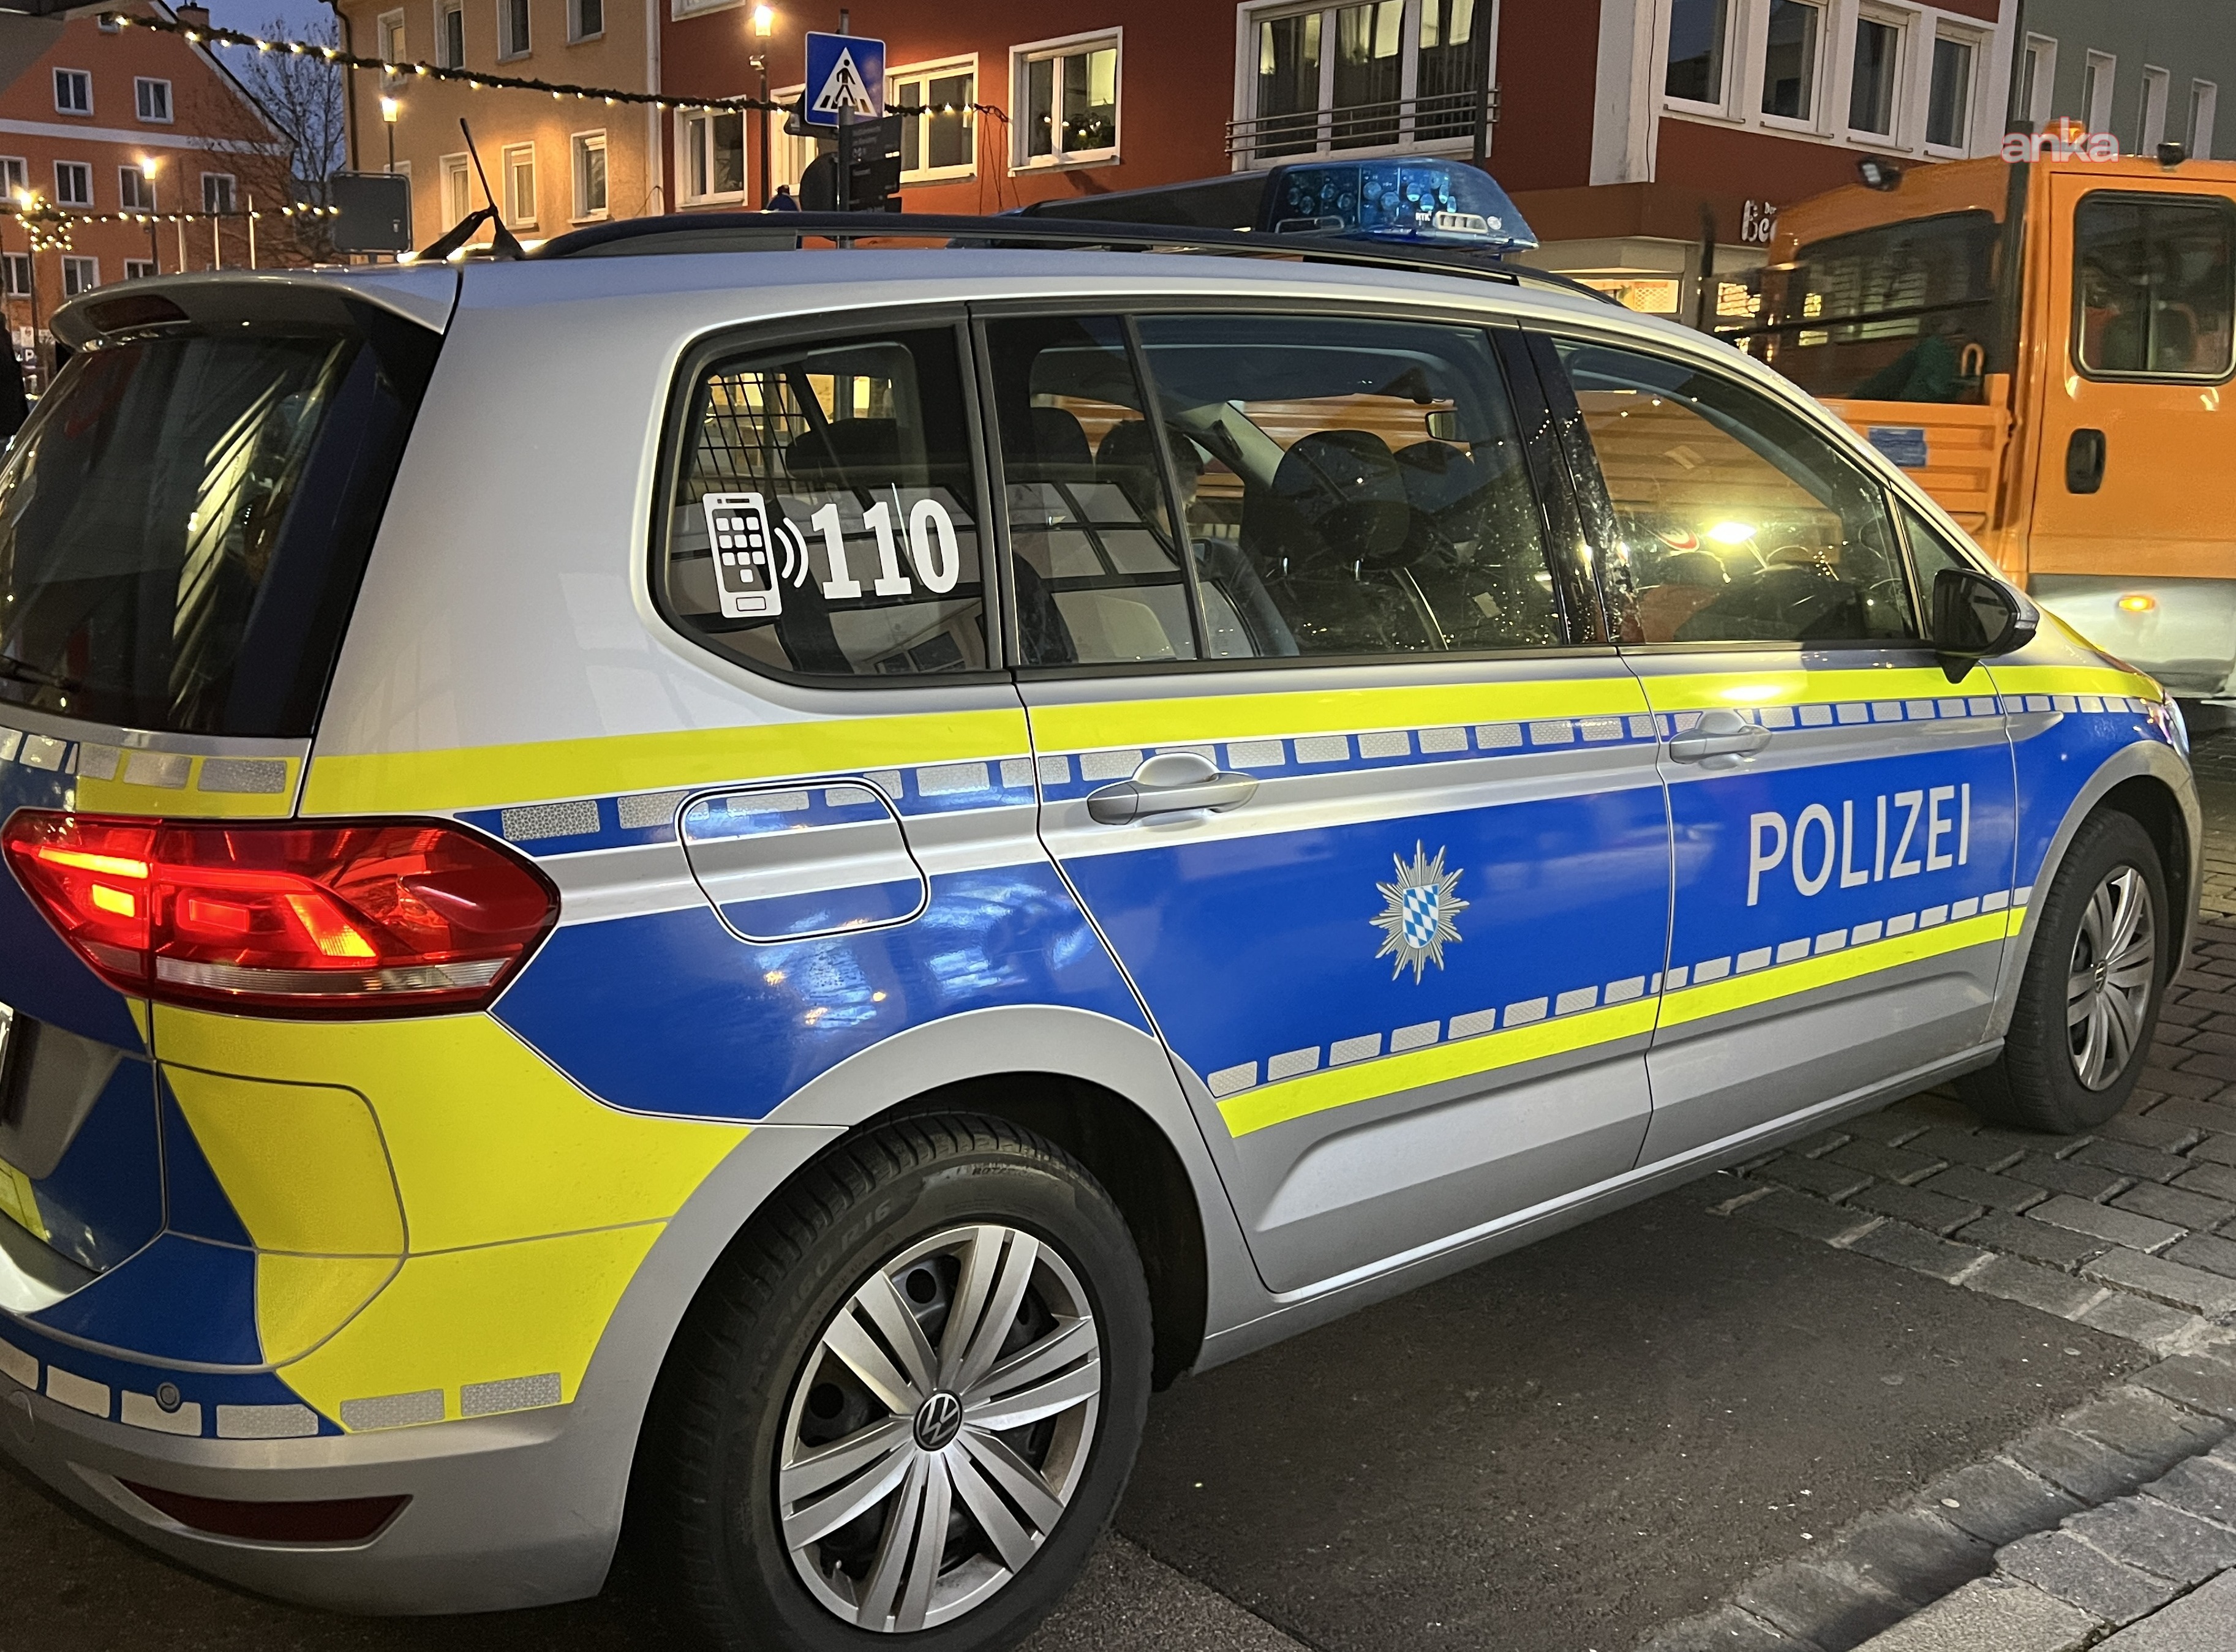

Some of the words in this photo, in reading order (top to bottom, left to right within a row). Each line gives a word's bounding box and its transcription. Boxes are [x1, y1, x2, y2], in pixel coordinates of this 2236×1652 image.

[26, 350, 34, 361] P
[811, 498, 960, 599] 110
[1747, 783, 1970, 906] POLIZEI
